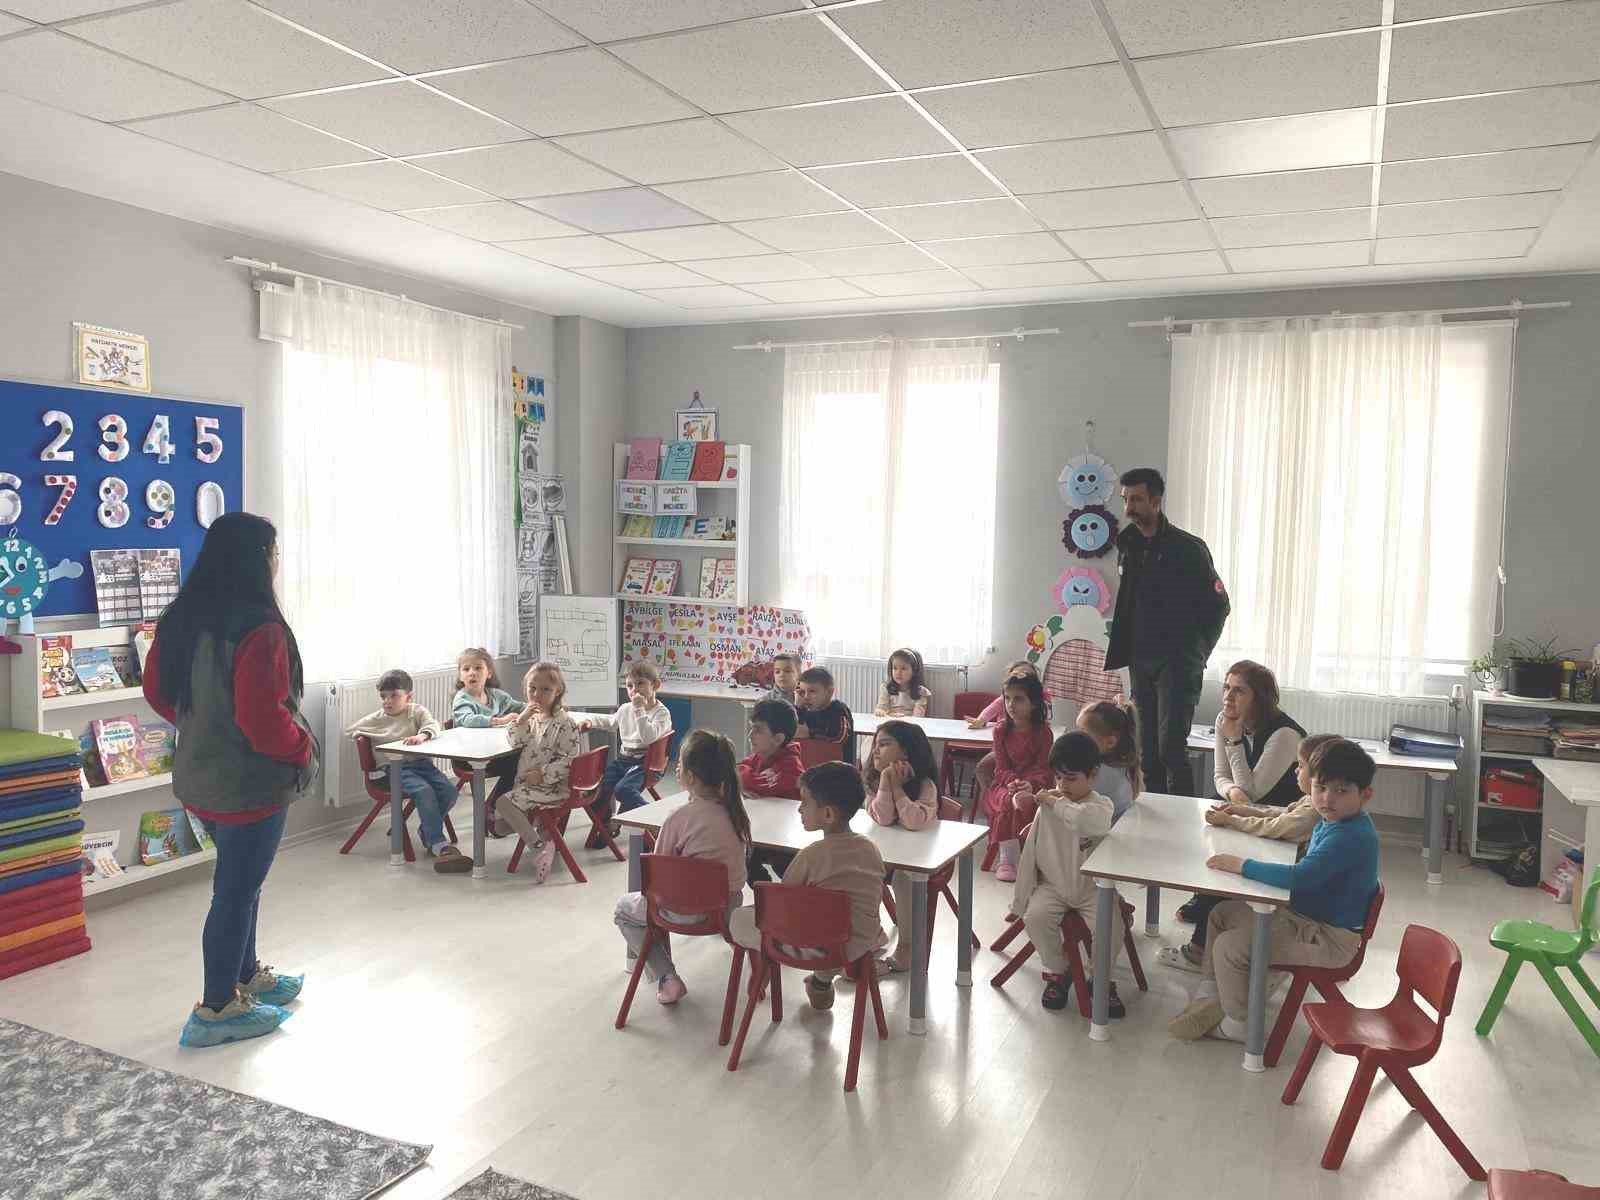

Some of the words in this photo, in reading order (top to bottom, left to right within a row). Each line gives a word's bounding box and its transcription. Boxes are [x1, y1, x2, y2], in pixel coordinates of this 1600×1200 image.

[40, 410, 74, 462] 2
[98, 413, 130, 463] 3
[143, 414, 176, 464] 4
[195, 416, 223, 464] 5
[0, 472, 22, 526] 6
[44, 475, 77, 525] 7
[97, 476, 130, 528] 8
[145, 479, 175, 529] 9
[196, 480, 225, 529] 0
[3, 540, 20, 552] 12
[25, 546, 32, 559] 1
[33, 557, 44, 569] 2
[38, 570, 47, 583] 3
[33, 587, 43, 599] 4
[6, 601, 16, 614] 6
[22, 597, 32, 611] 5
[716, 611, 737, 623] AYŞE
[752, 612, 777, 622] RAVZA
[632, 639, 662, 648] MASAL
[709, 643, 741, 653] OSMAN
[755, 646, 775, 657] AYAZ
[81, 840, 113, 849] ÜVERCİN
